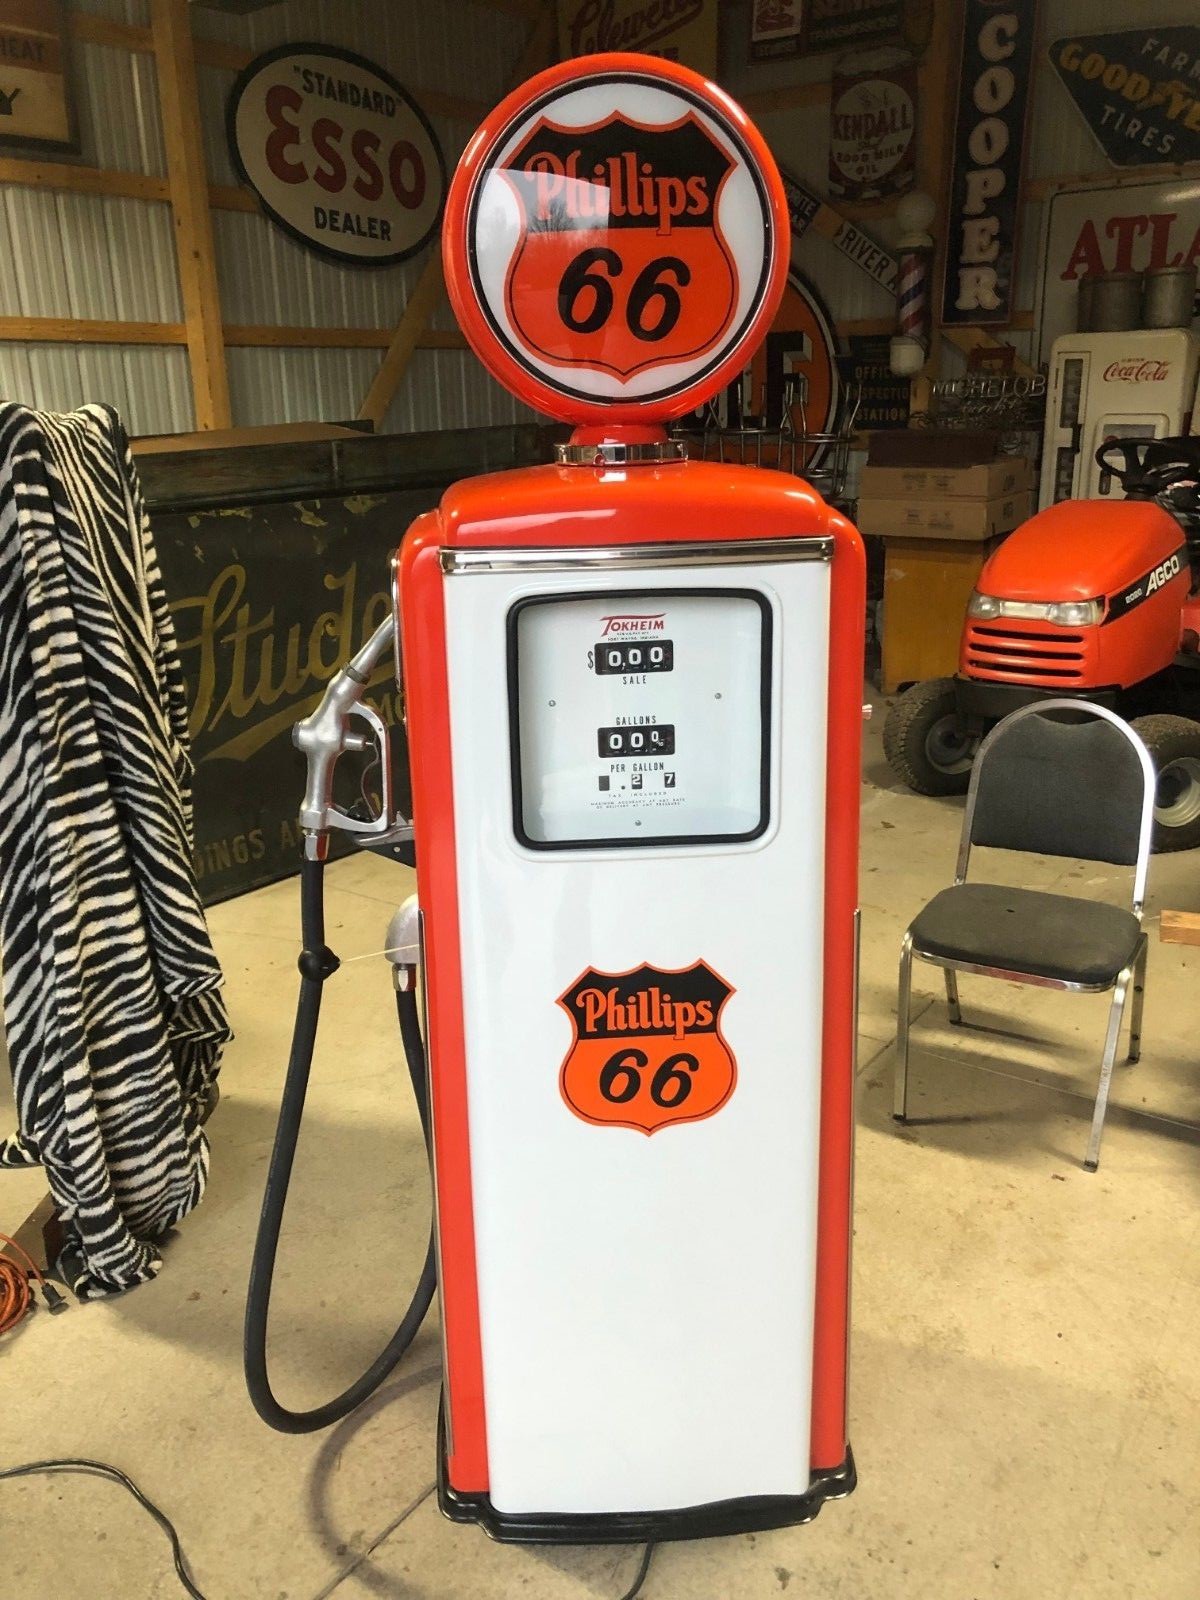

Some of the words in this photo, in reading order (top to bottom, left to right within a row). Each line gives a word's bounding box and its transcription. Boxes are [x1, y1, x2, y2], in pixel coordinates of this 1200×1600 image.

[265, 85, 426, 210] ESSO
[1100, 105, 1176, 154] TIRES
[954, 13, 1020, 310] COOPER
[524, 150, 710, 235] Phillips
[313, 206, 392, 241] DEALER
[840, 228, 890, 279] RIVER
[557, 246, 691, 342] 66
[1146, 555, 1180, 596] AGCO
[600, 613, 666, 637] TOKHEIM
[623, 675, 647, 684] SALE
[616, 716, 656, 726] GALLONS
[610, 764, 626, 772] PER
[632, 762, 664, 772] GALLON
[576, 987, 713, 1040] Phillips
[598, 1048, 699, 1108] 66
